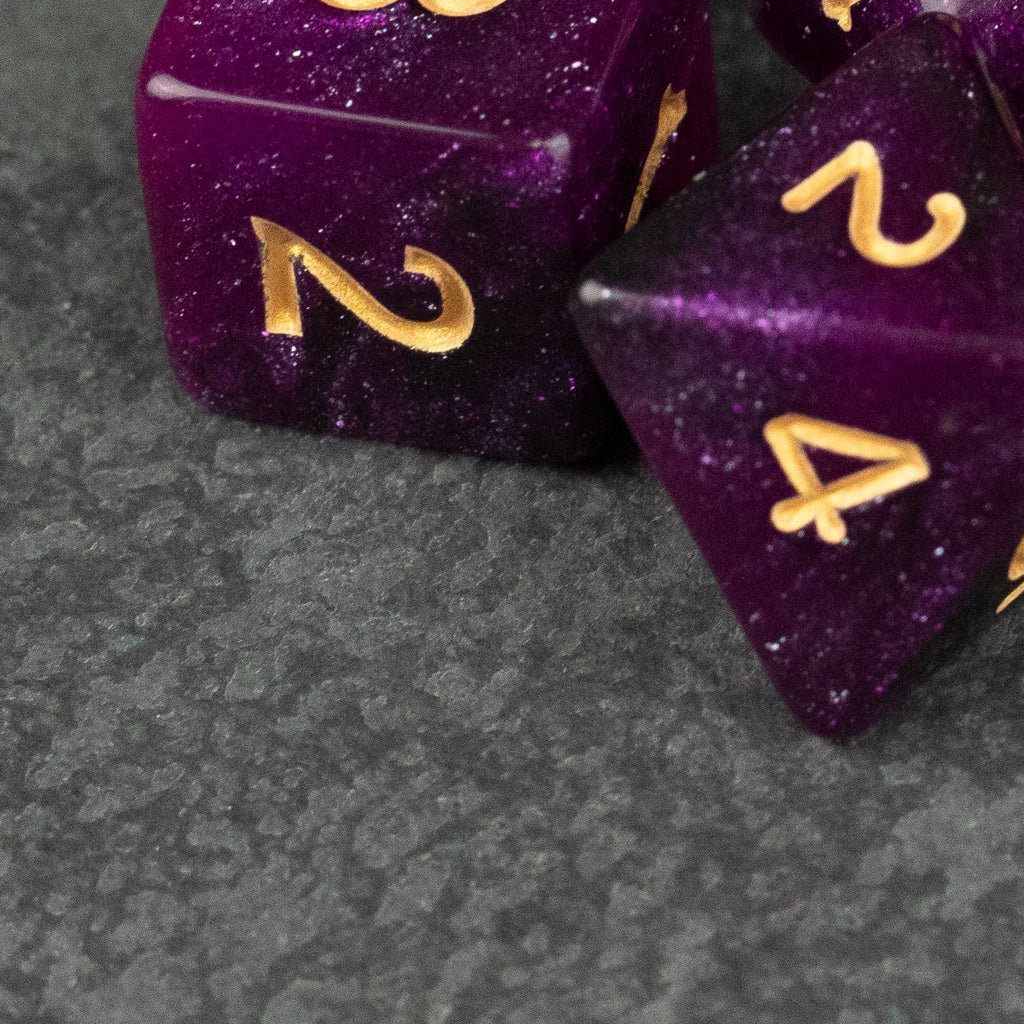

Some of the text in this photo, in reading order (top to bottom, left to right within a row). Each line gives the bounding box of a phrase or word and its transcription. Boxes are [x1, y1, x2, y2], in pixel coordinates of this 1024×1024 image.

[782, 140, 967, 267] 2
[251, 217, 476, 354] 2
[764, 415, 931, 544] 4
